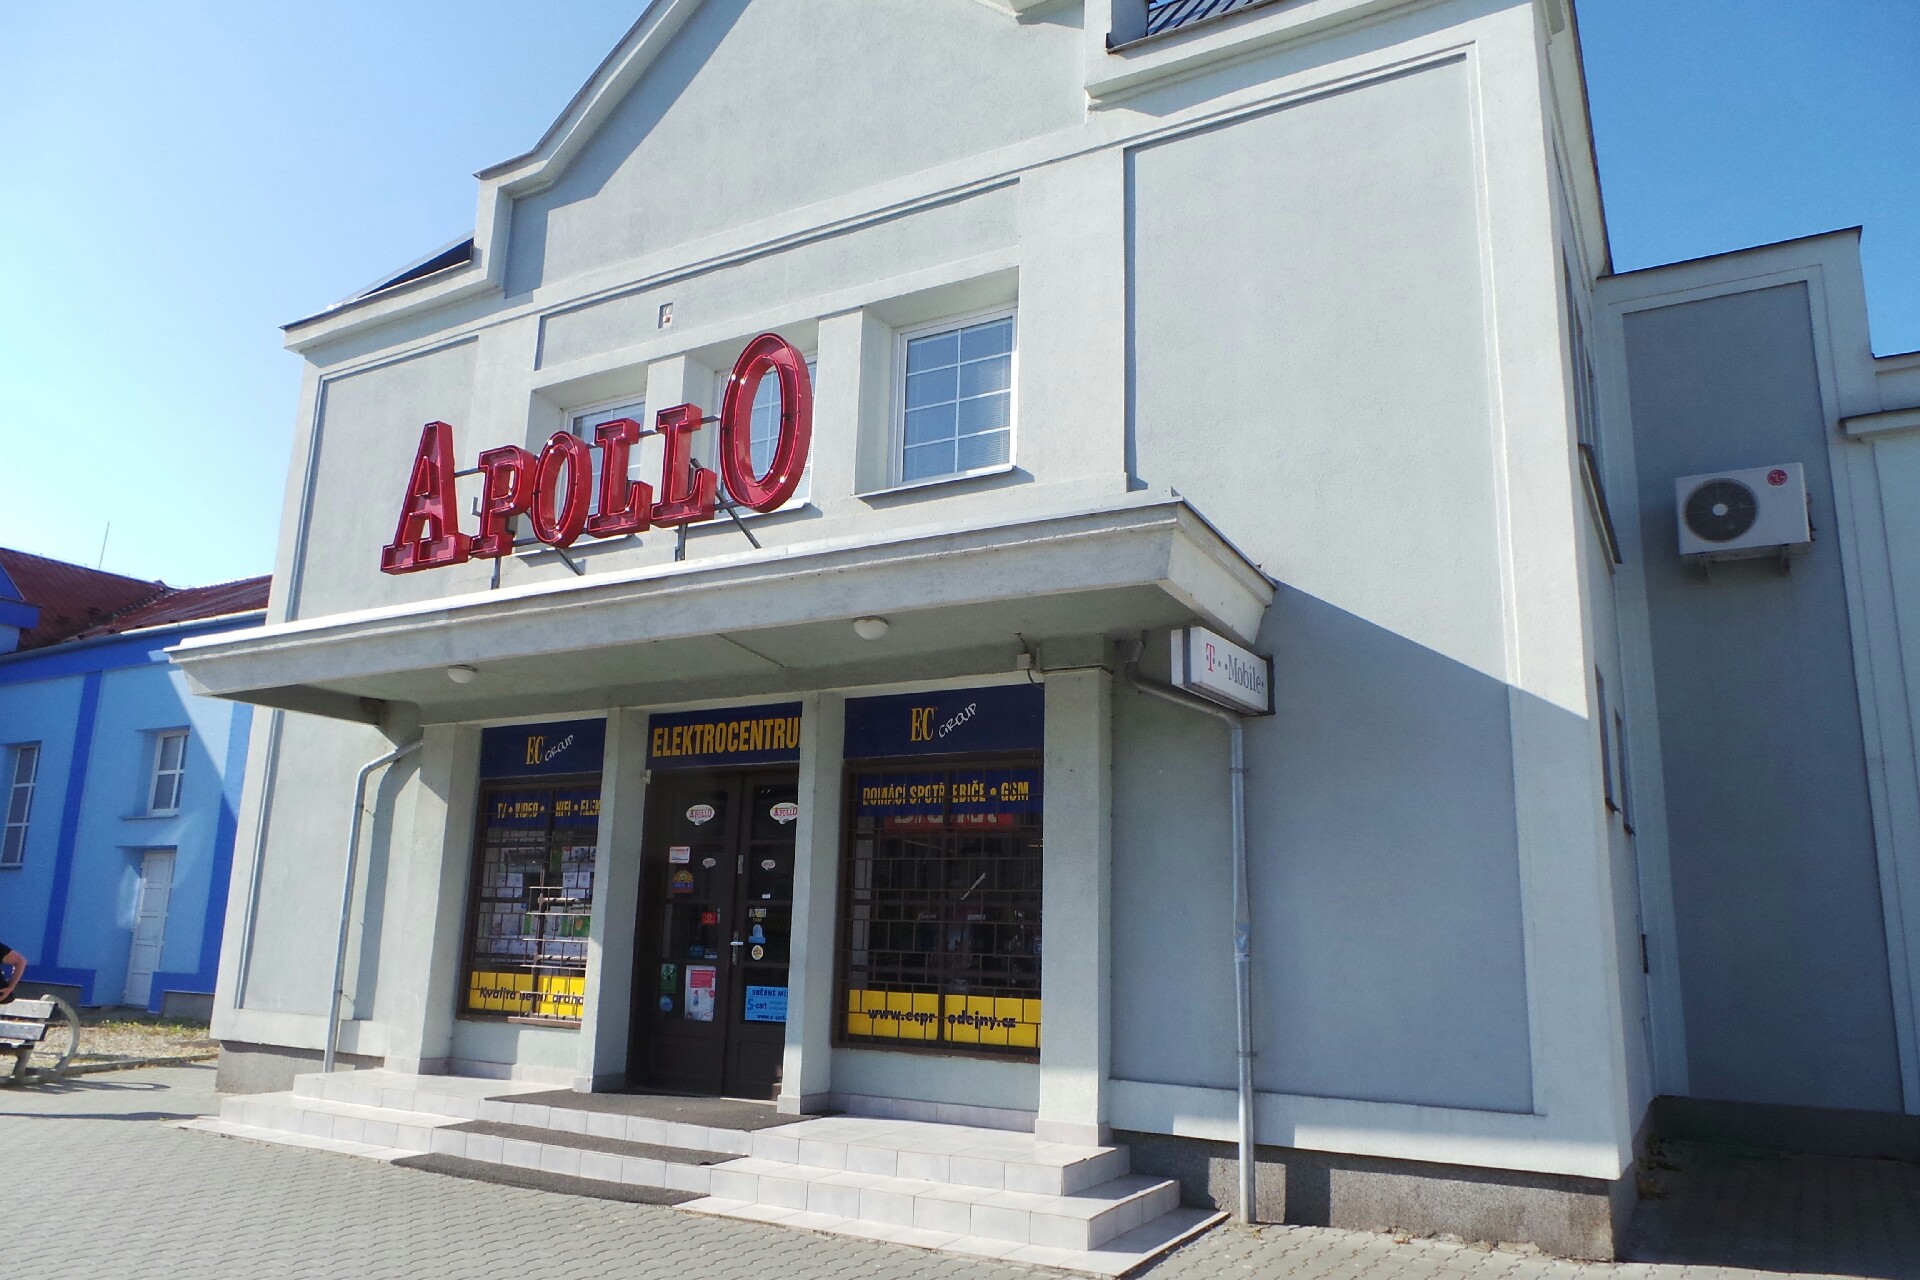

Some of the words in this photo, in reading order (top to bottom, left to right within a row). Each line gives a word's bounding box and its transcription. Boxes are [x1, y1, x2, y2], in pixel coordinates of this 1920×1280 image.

[380, 332, 812, 575] APOLLO
[910, 707, 935, 741] EC
[526, 736, 544, 765] EC
[1001, 781, 1029, 802] GSM
